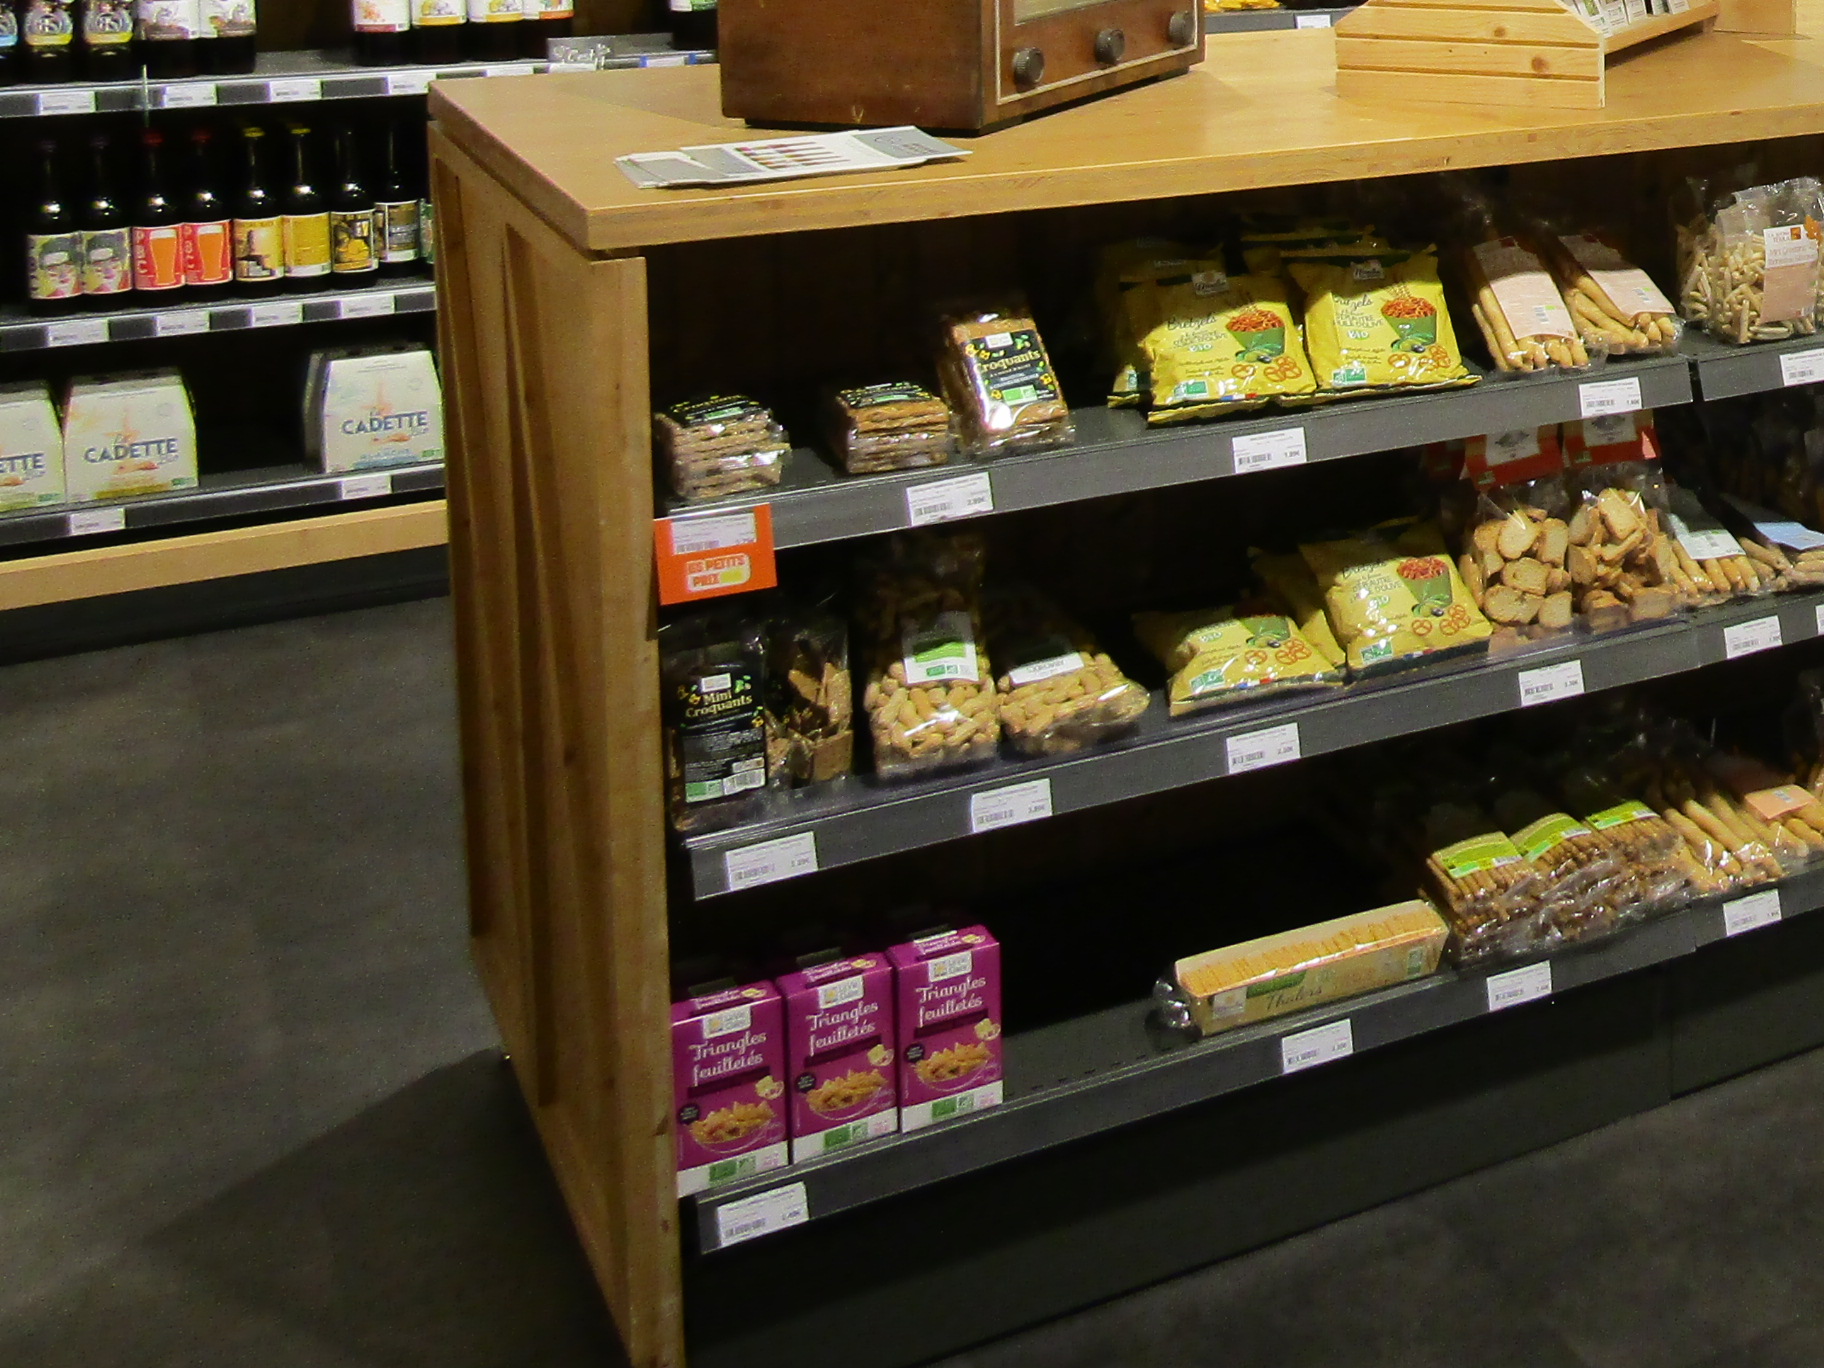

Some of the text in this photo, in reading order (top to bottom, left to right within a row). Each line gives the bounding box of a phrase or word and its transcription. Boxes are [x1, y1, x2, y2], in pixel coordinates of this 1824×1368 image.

[341, 410, 428, 435] CADETTE
[84, 437, 178, 463] CADETTE
[685, 694, 754, 720] Croquants
[702, 689, 732, 706] Mini
[915, 975, 987, 1004] Triangles
[805, 1001, 879, 1031] Triangles
[919, 994, 983, 1028] feuilletés
[688, 1031, 767, 1062] Triangles
[809, 1019, 876, 1057] feuilletés
[692, 1052, 764, 1087] feuilletés
